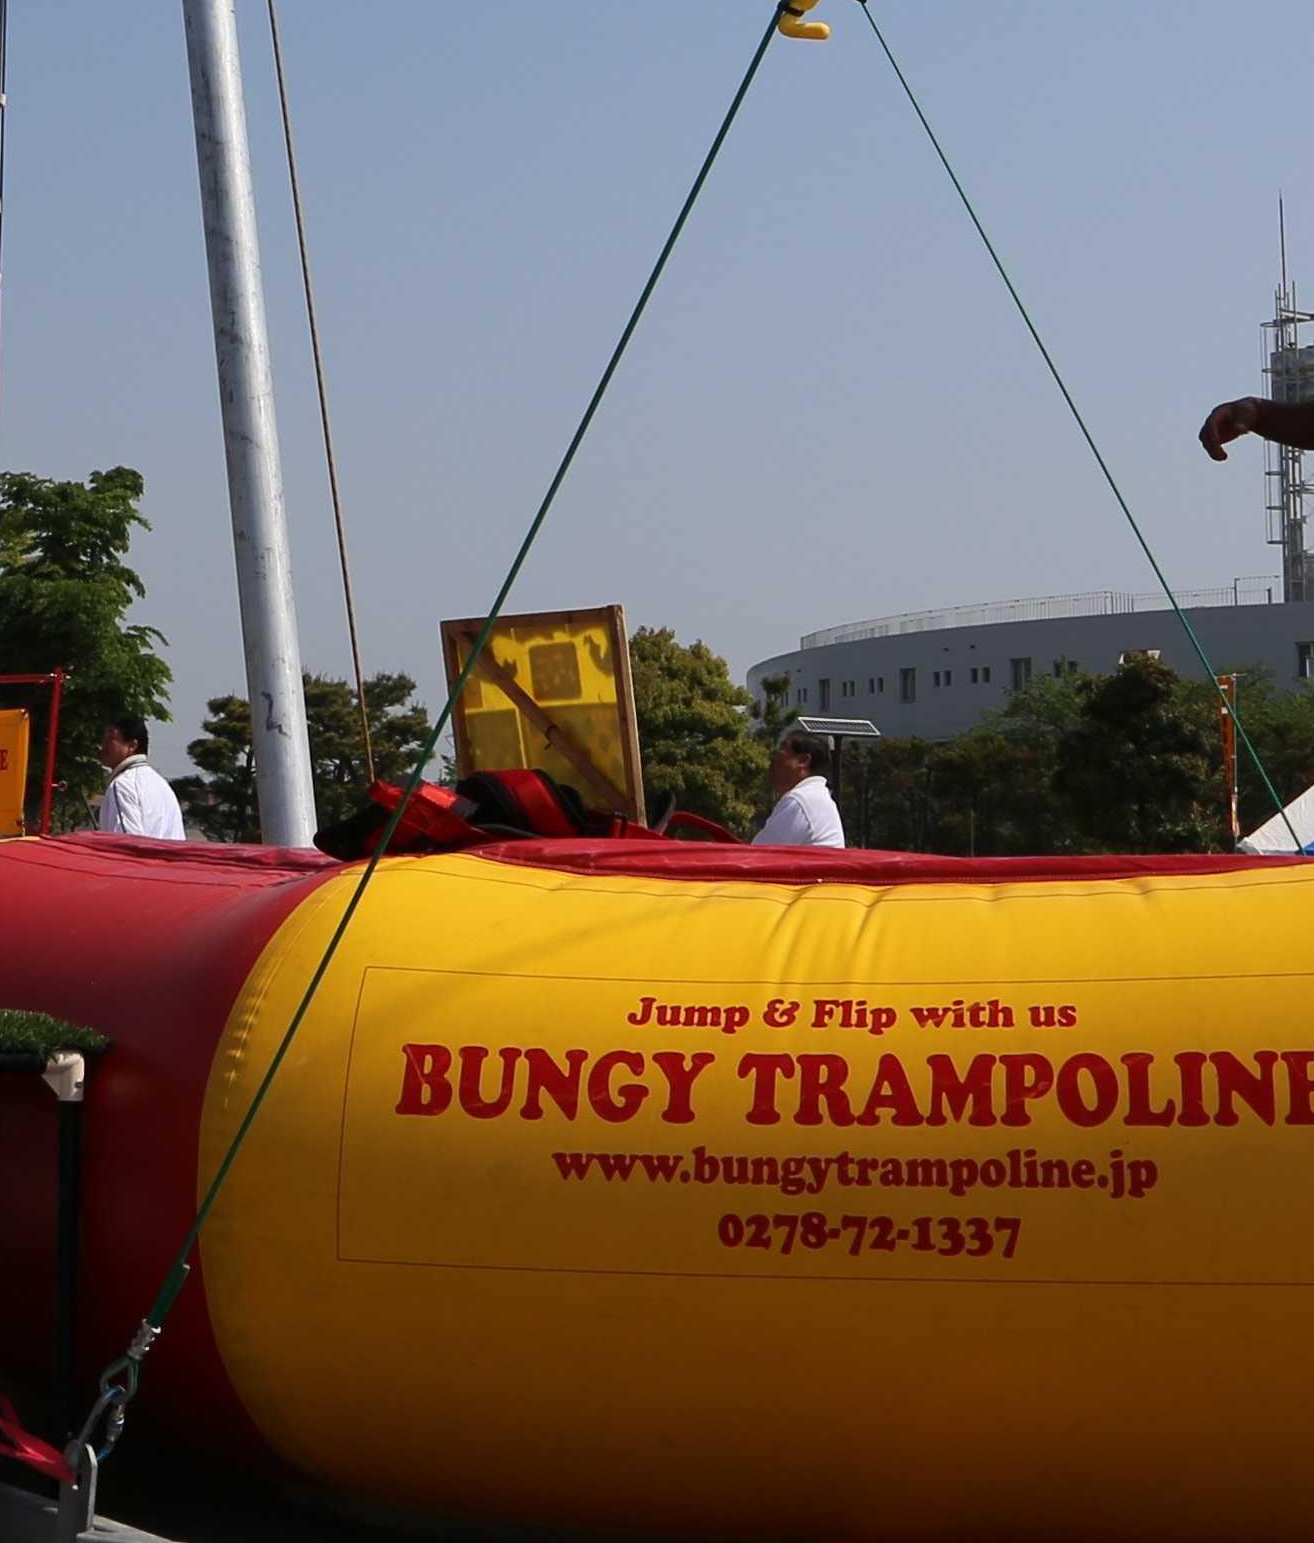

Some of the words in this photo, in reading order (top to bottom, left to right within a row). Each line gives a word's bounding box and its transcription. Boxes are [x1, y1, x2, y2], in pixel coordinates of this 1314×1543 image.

[628, 997, 750, 1034] Jump
[762, 999, 800, 1028] &
[811, 1000, 896, 1035] Flip
[909, 1000, 1015, 1028] with
[1028, 1004, 1077, 1028] us
[395, 1043, 715, 1124] BUNGY
[552, 1146, 1158, 1199] www.bungytrampoline.jp
[718, 1212, 1022, 1258] 0278-72-1337
